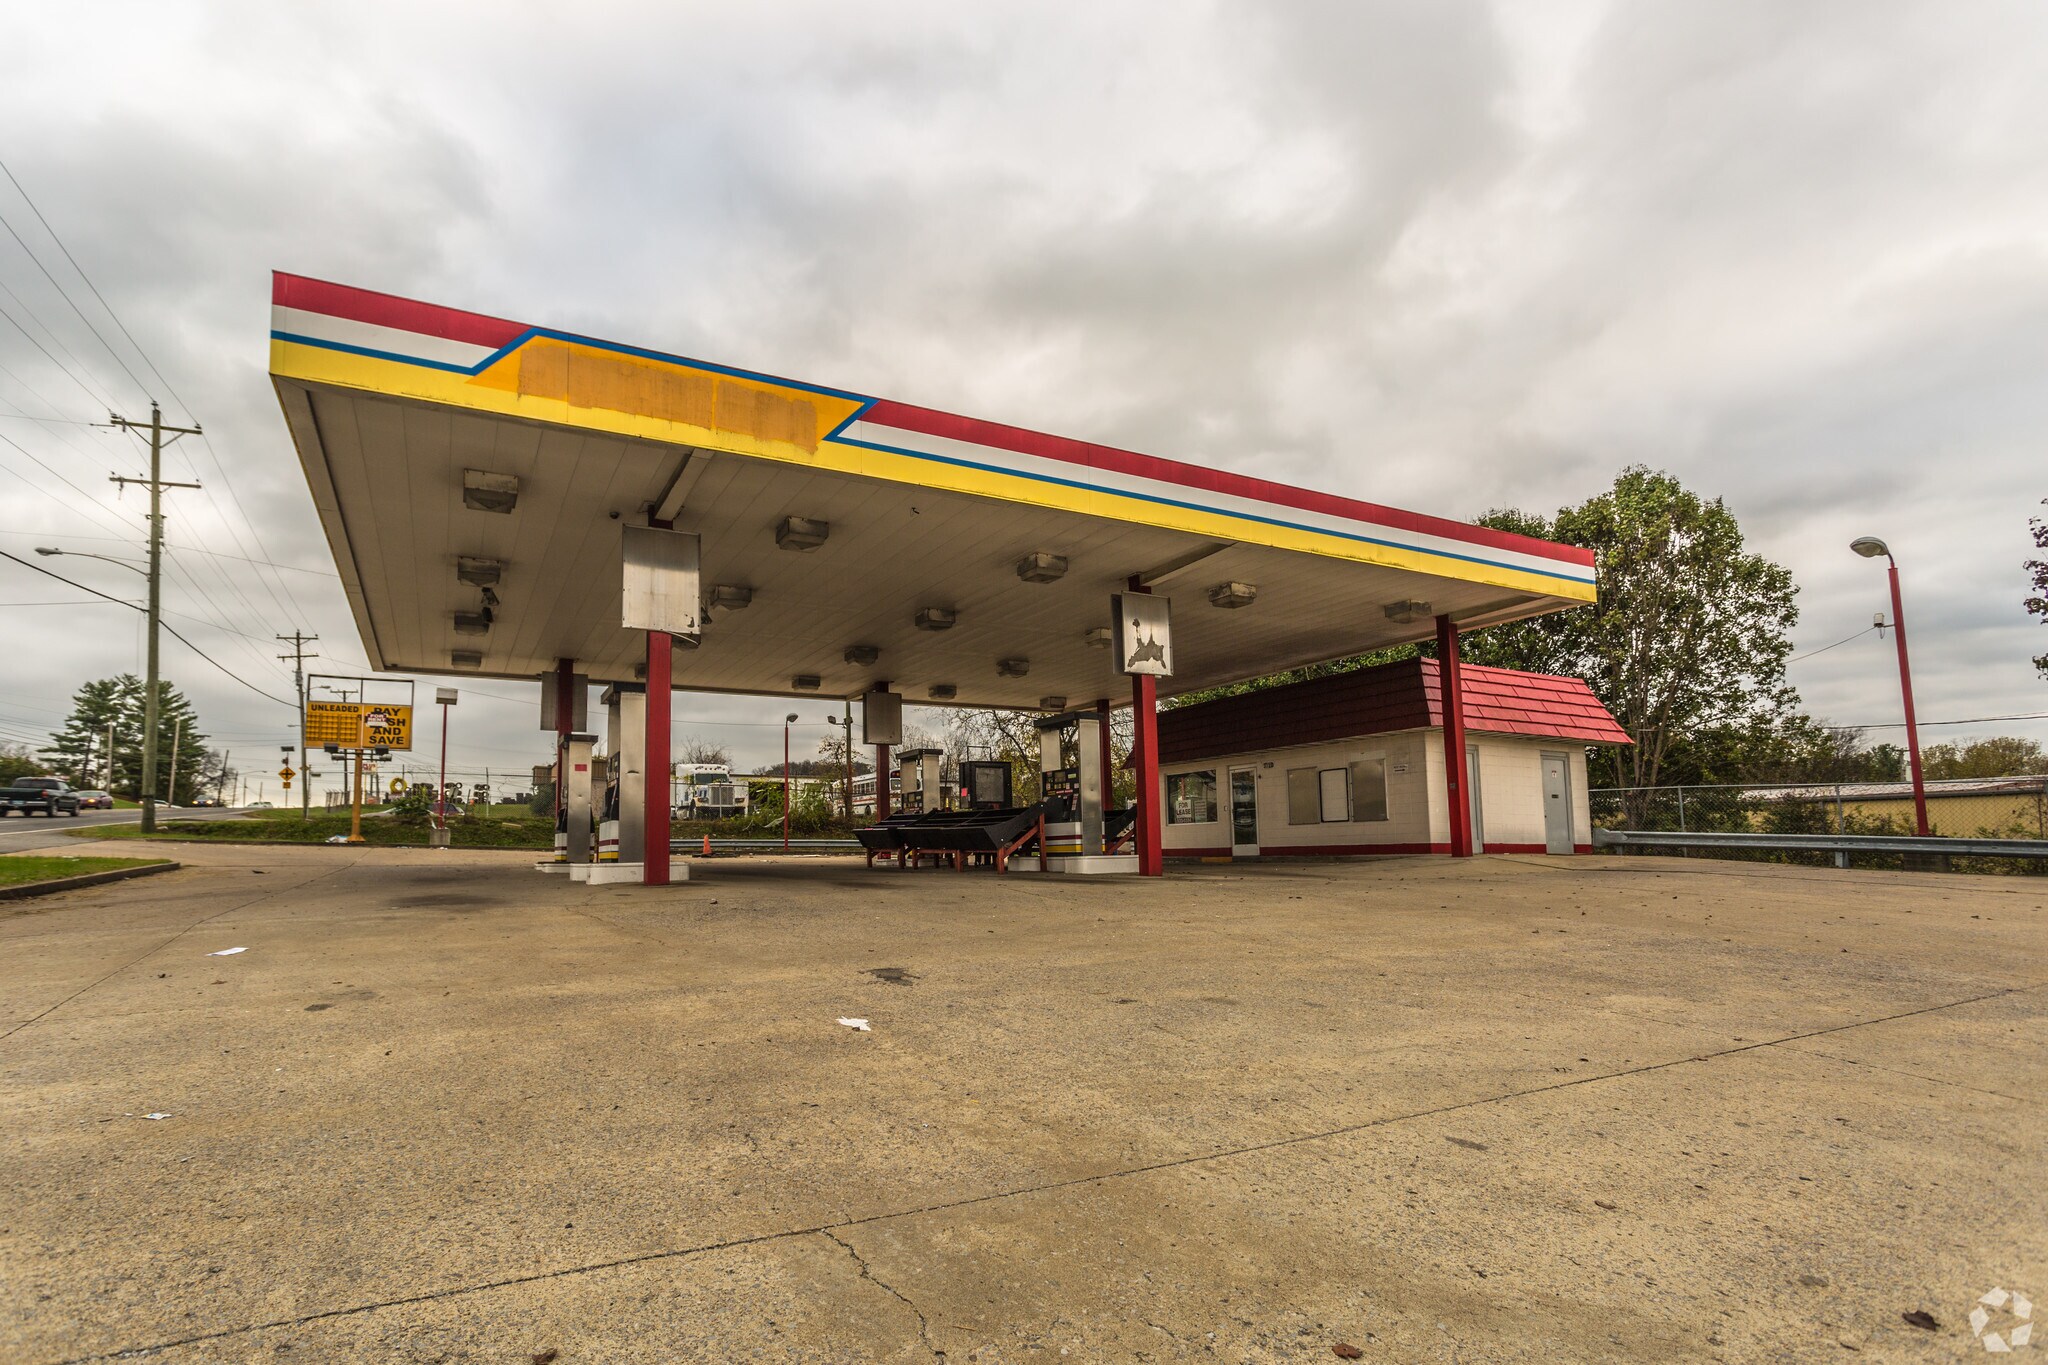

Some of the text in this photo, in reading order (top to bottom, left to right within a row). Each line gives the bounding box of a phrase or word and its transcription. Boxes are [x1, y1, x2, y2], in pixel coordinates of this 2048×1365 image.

[311, 704, 359, 713] UNLEADED
[373, 707, 401, 716] PAY
[369, 736, 404, 744] SAVE
